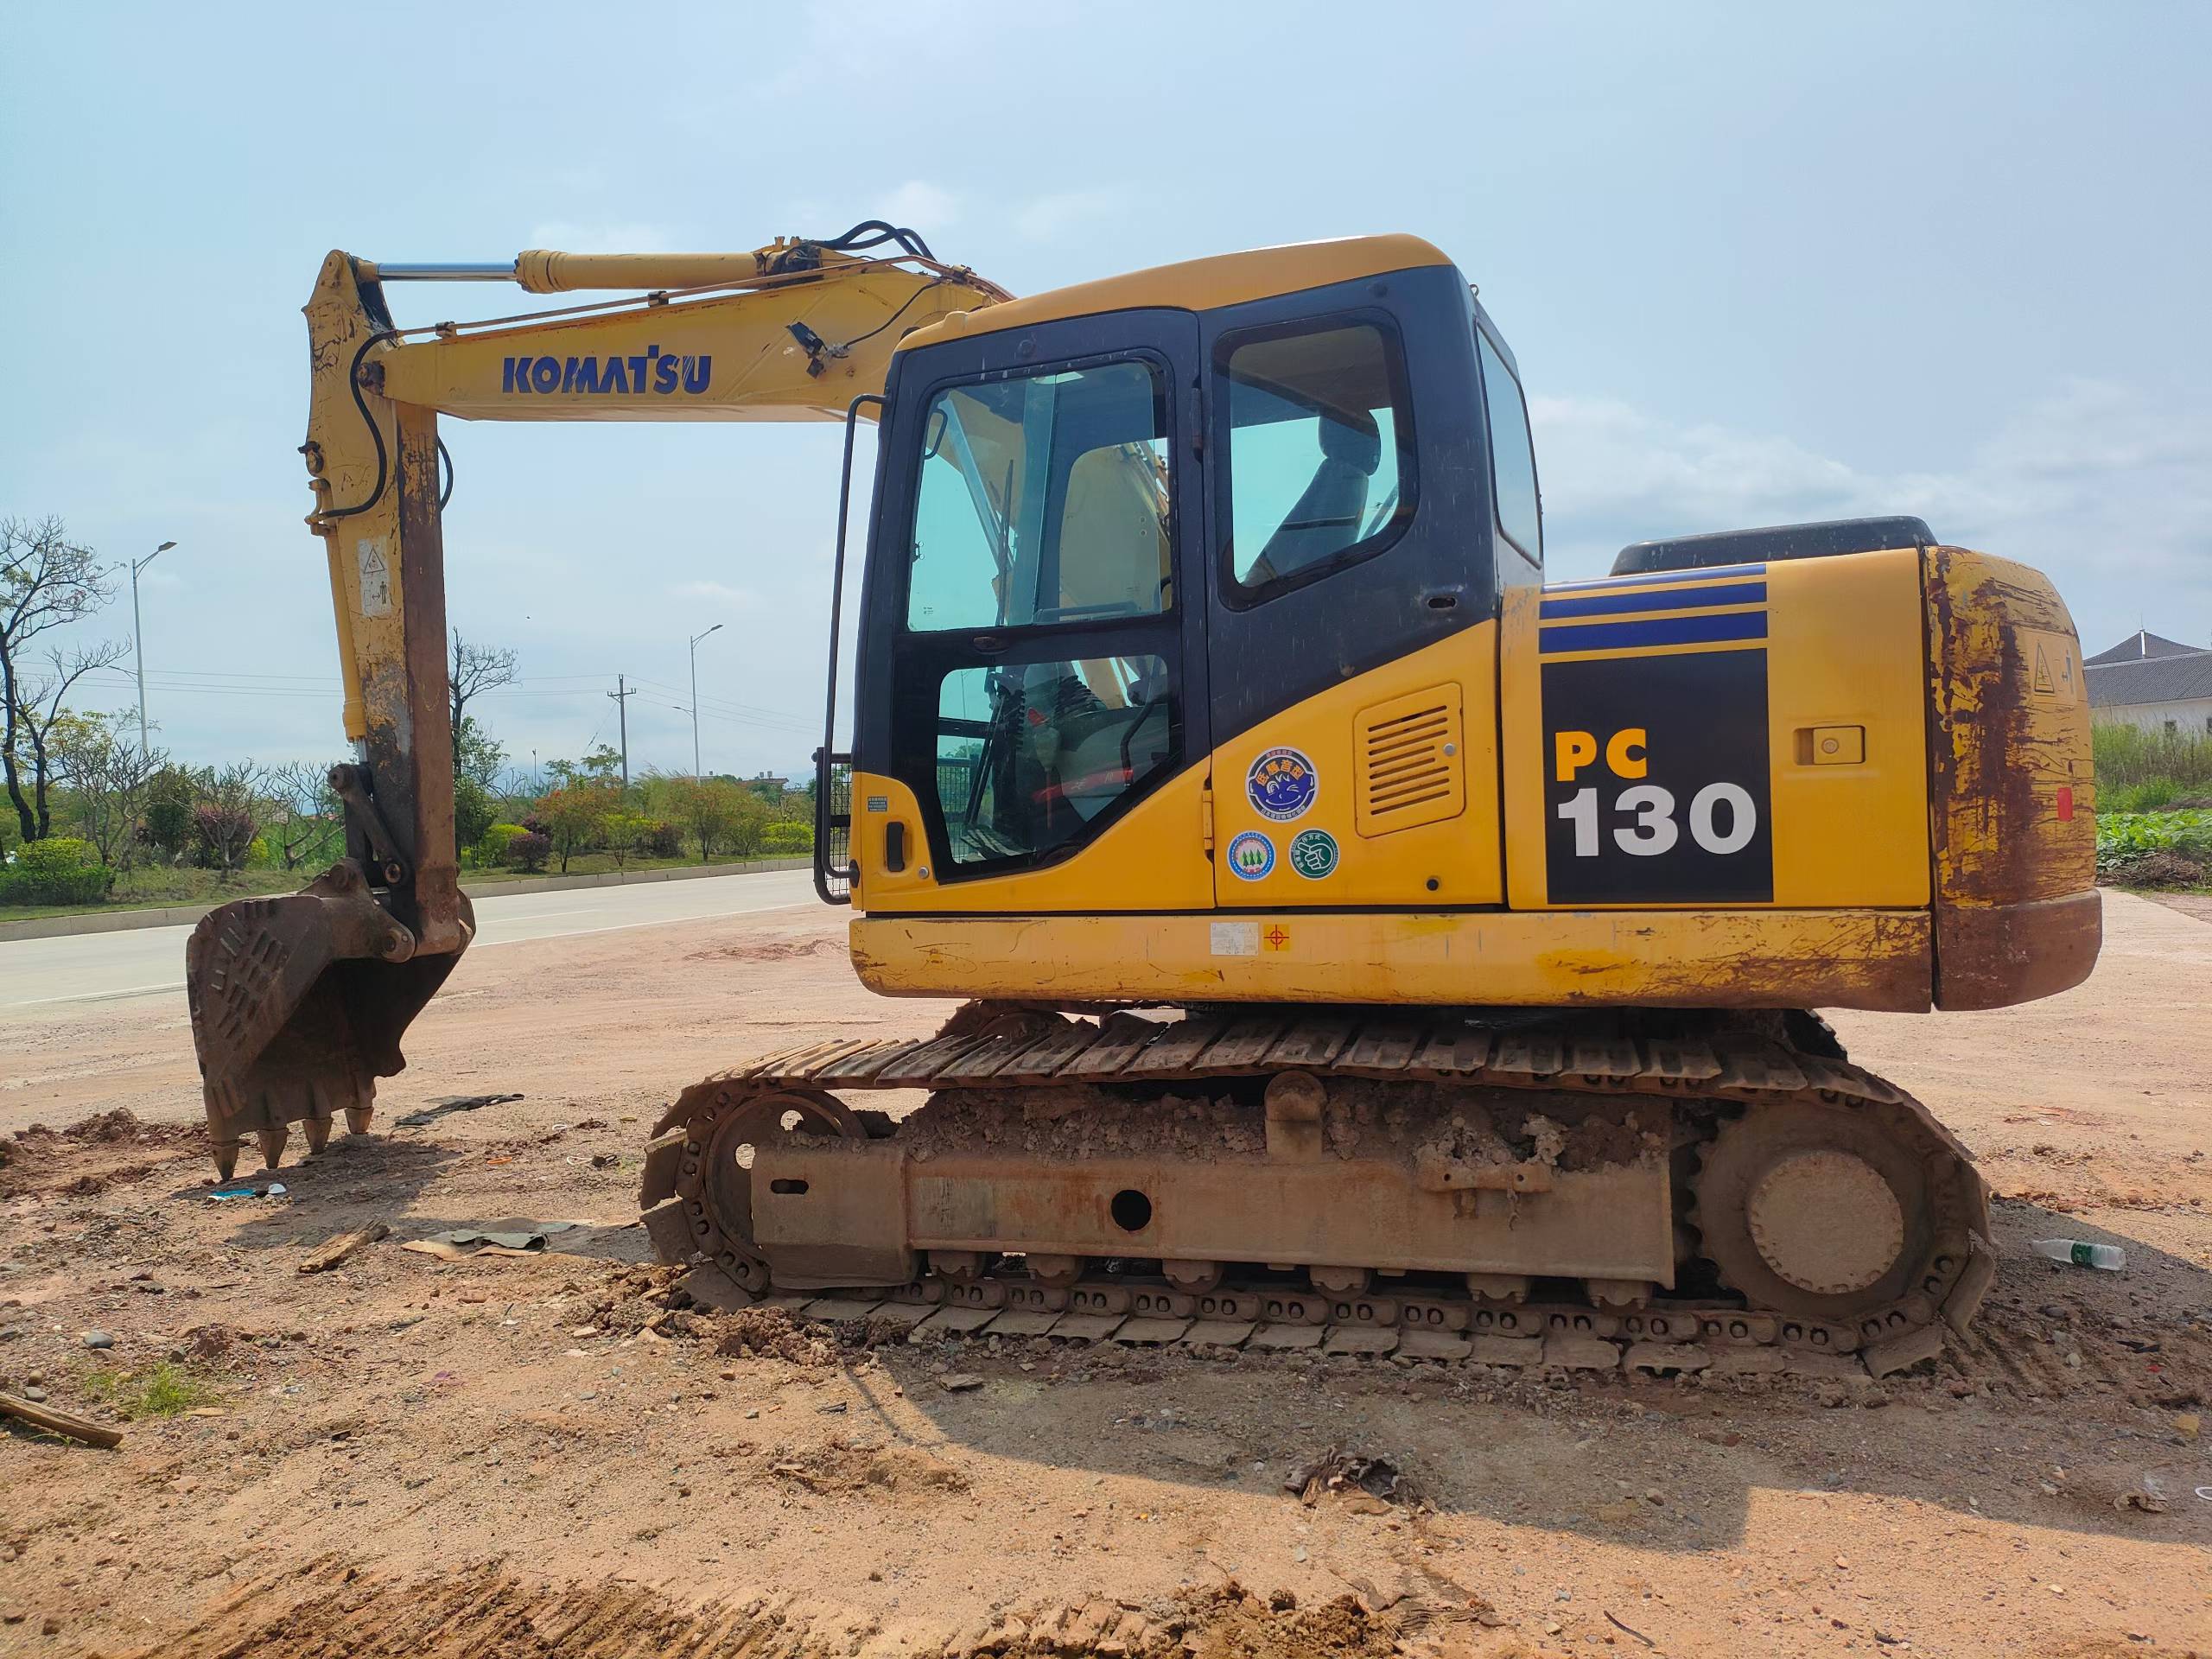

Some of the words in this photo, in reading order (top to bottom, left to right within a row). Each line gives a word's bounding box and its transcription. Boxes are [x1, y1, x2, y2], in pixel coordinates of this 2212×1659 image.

[502, 345, 712, 395] KOMATSU
[1555, 728, 1647, 782] PC
[1557, 782, 1757, 857] 130
